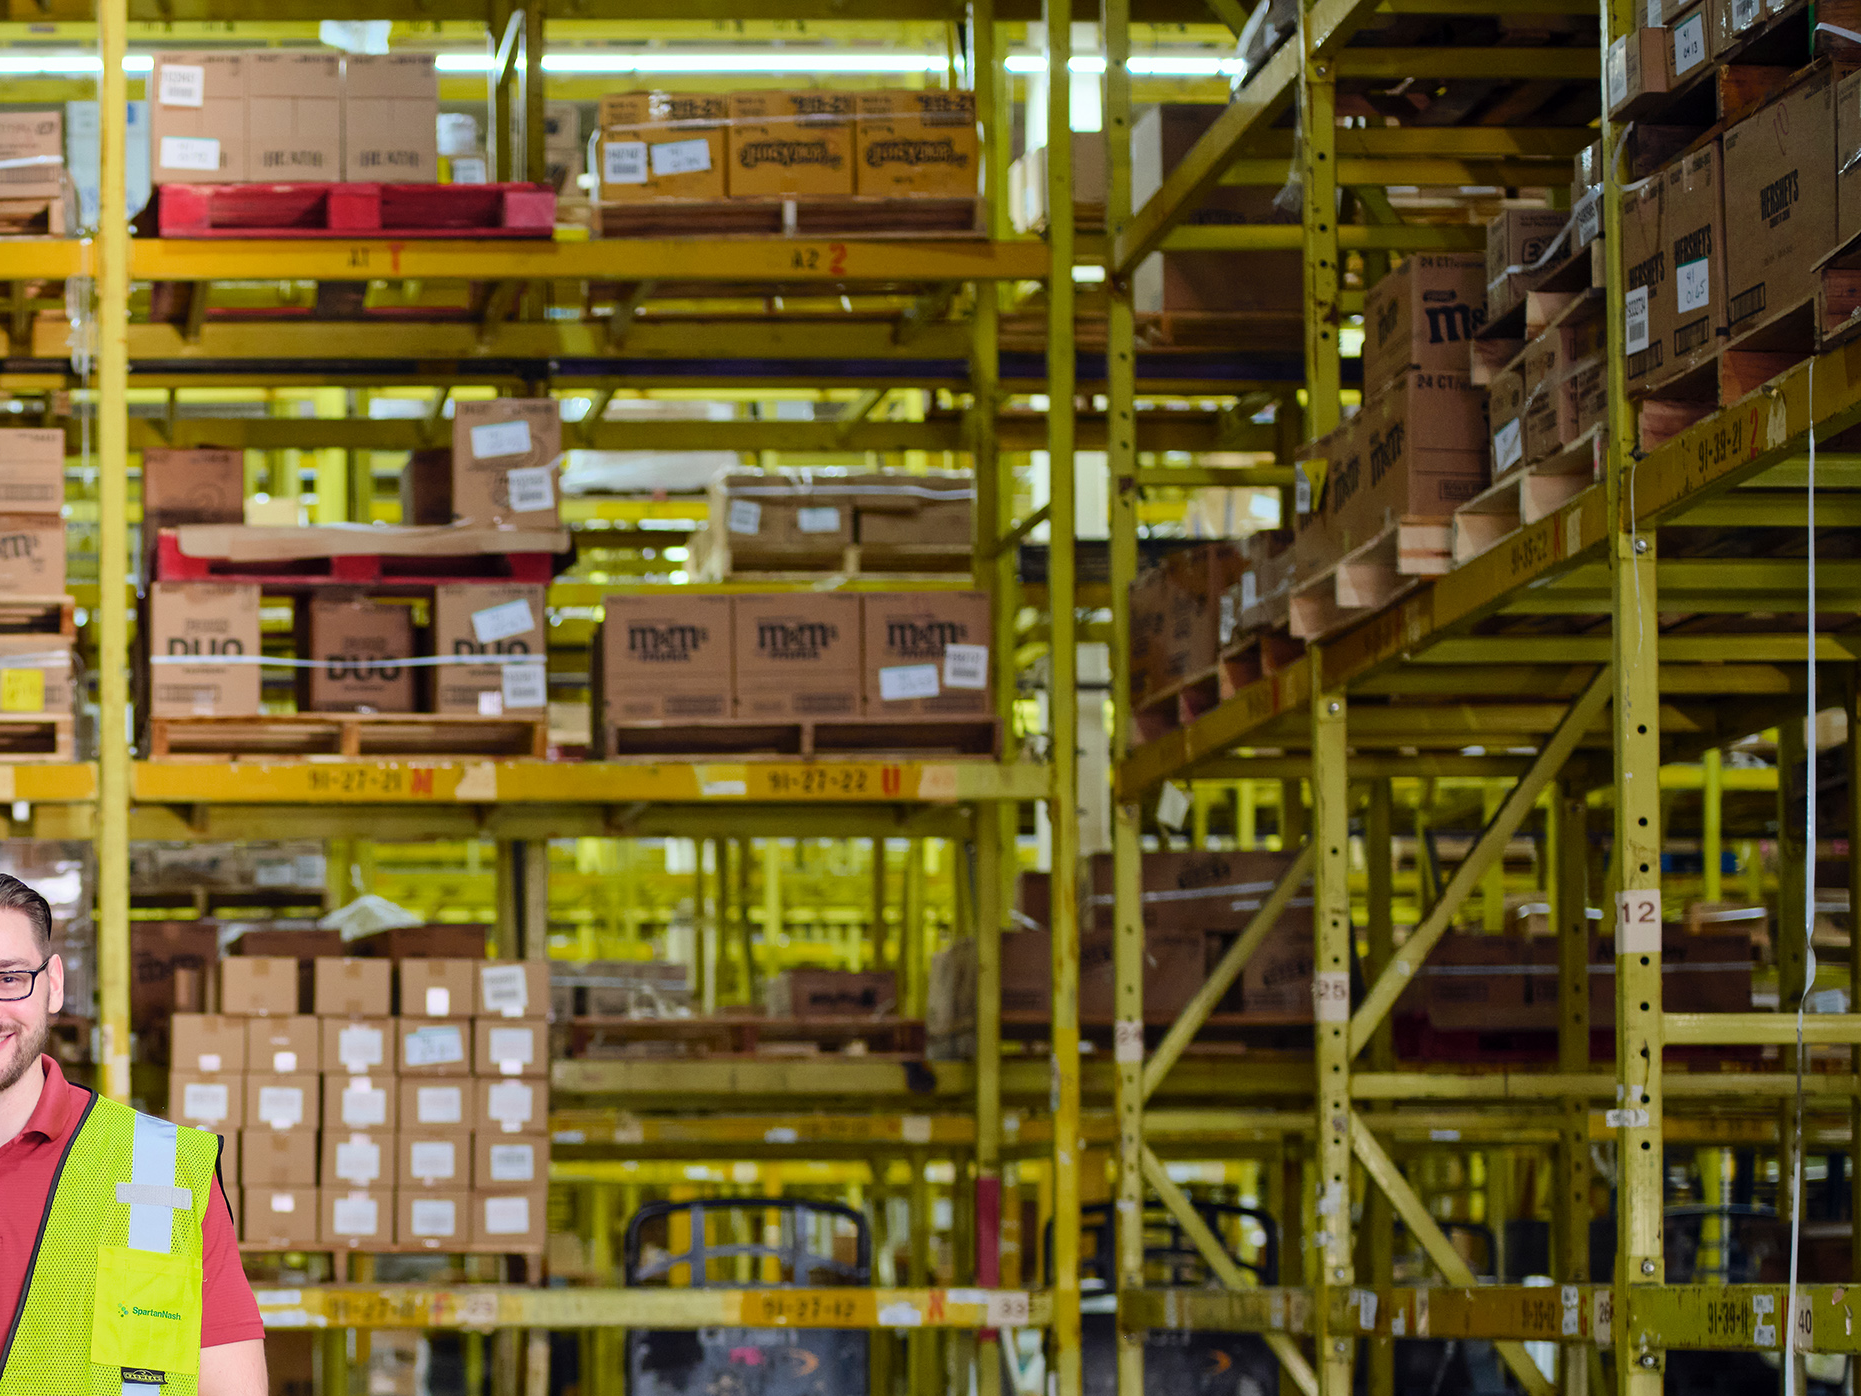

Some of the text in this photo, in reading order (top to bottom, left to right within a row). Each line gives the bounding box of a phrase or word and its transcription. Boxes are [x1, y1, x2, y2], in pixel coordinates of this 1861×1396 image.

[1761, 168, 1800, 222] HERSHEY'S
[829, 244, 848, 276] 2
[1418, 374, 1433, 389] 24
[1697, 425, 1744, 474] 91-39-21
[326, 654, 402, 682] DUO
[767, 768, 868, 793] 91-27-22
[880, 766, 901, 798] U
[1620, 901, 1657, 924] 12
[132, 1306, 182, 1321] SpartanNash
[1707, 1301, 1749, 1336] 91-39-11
[1797, 1308, 1813, 1335] 40
